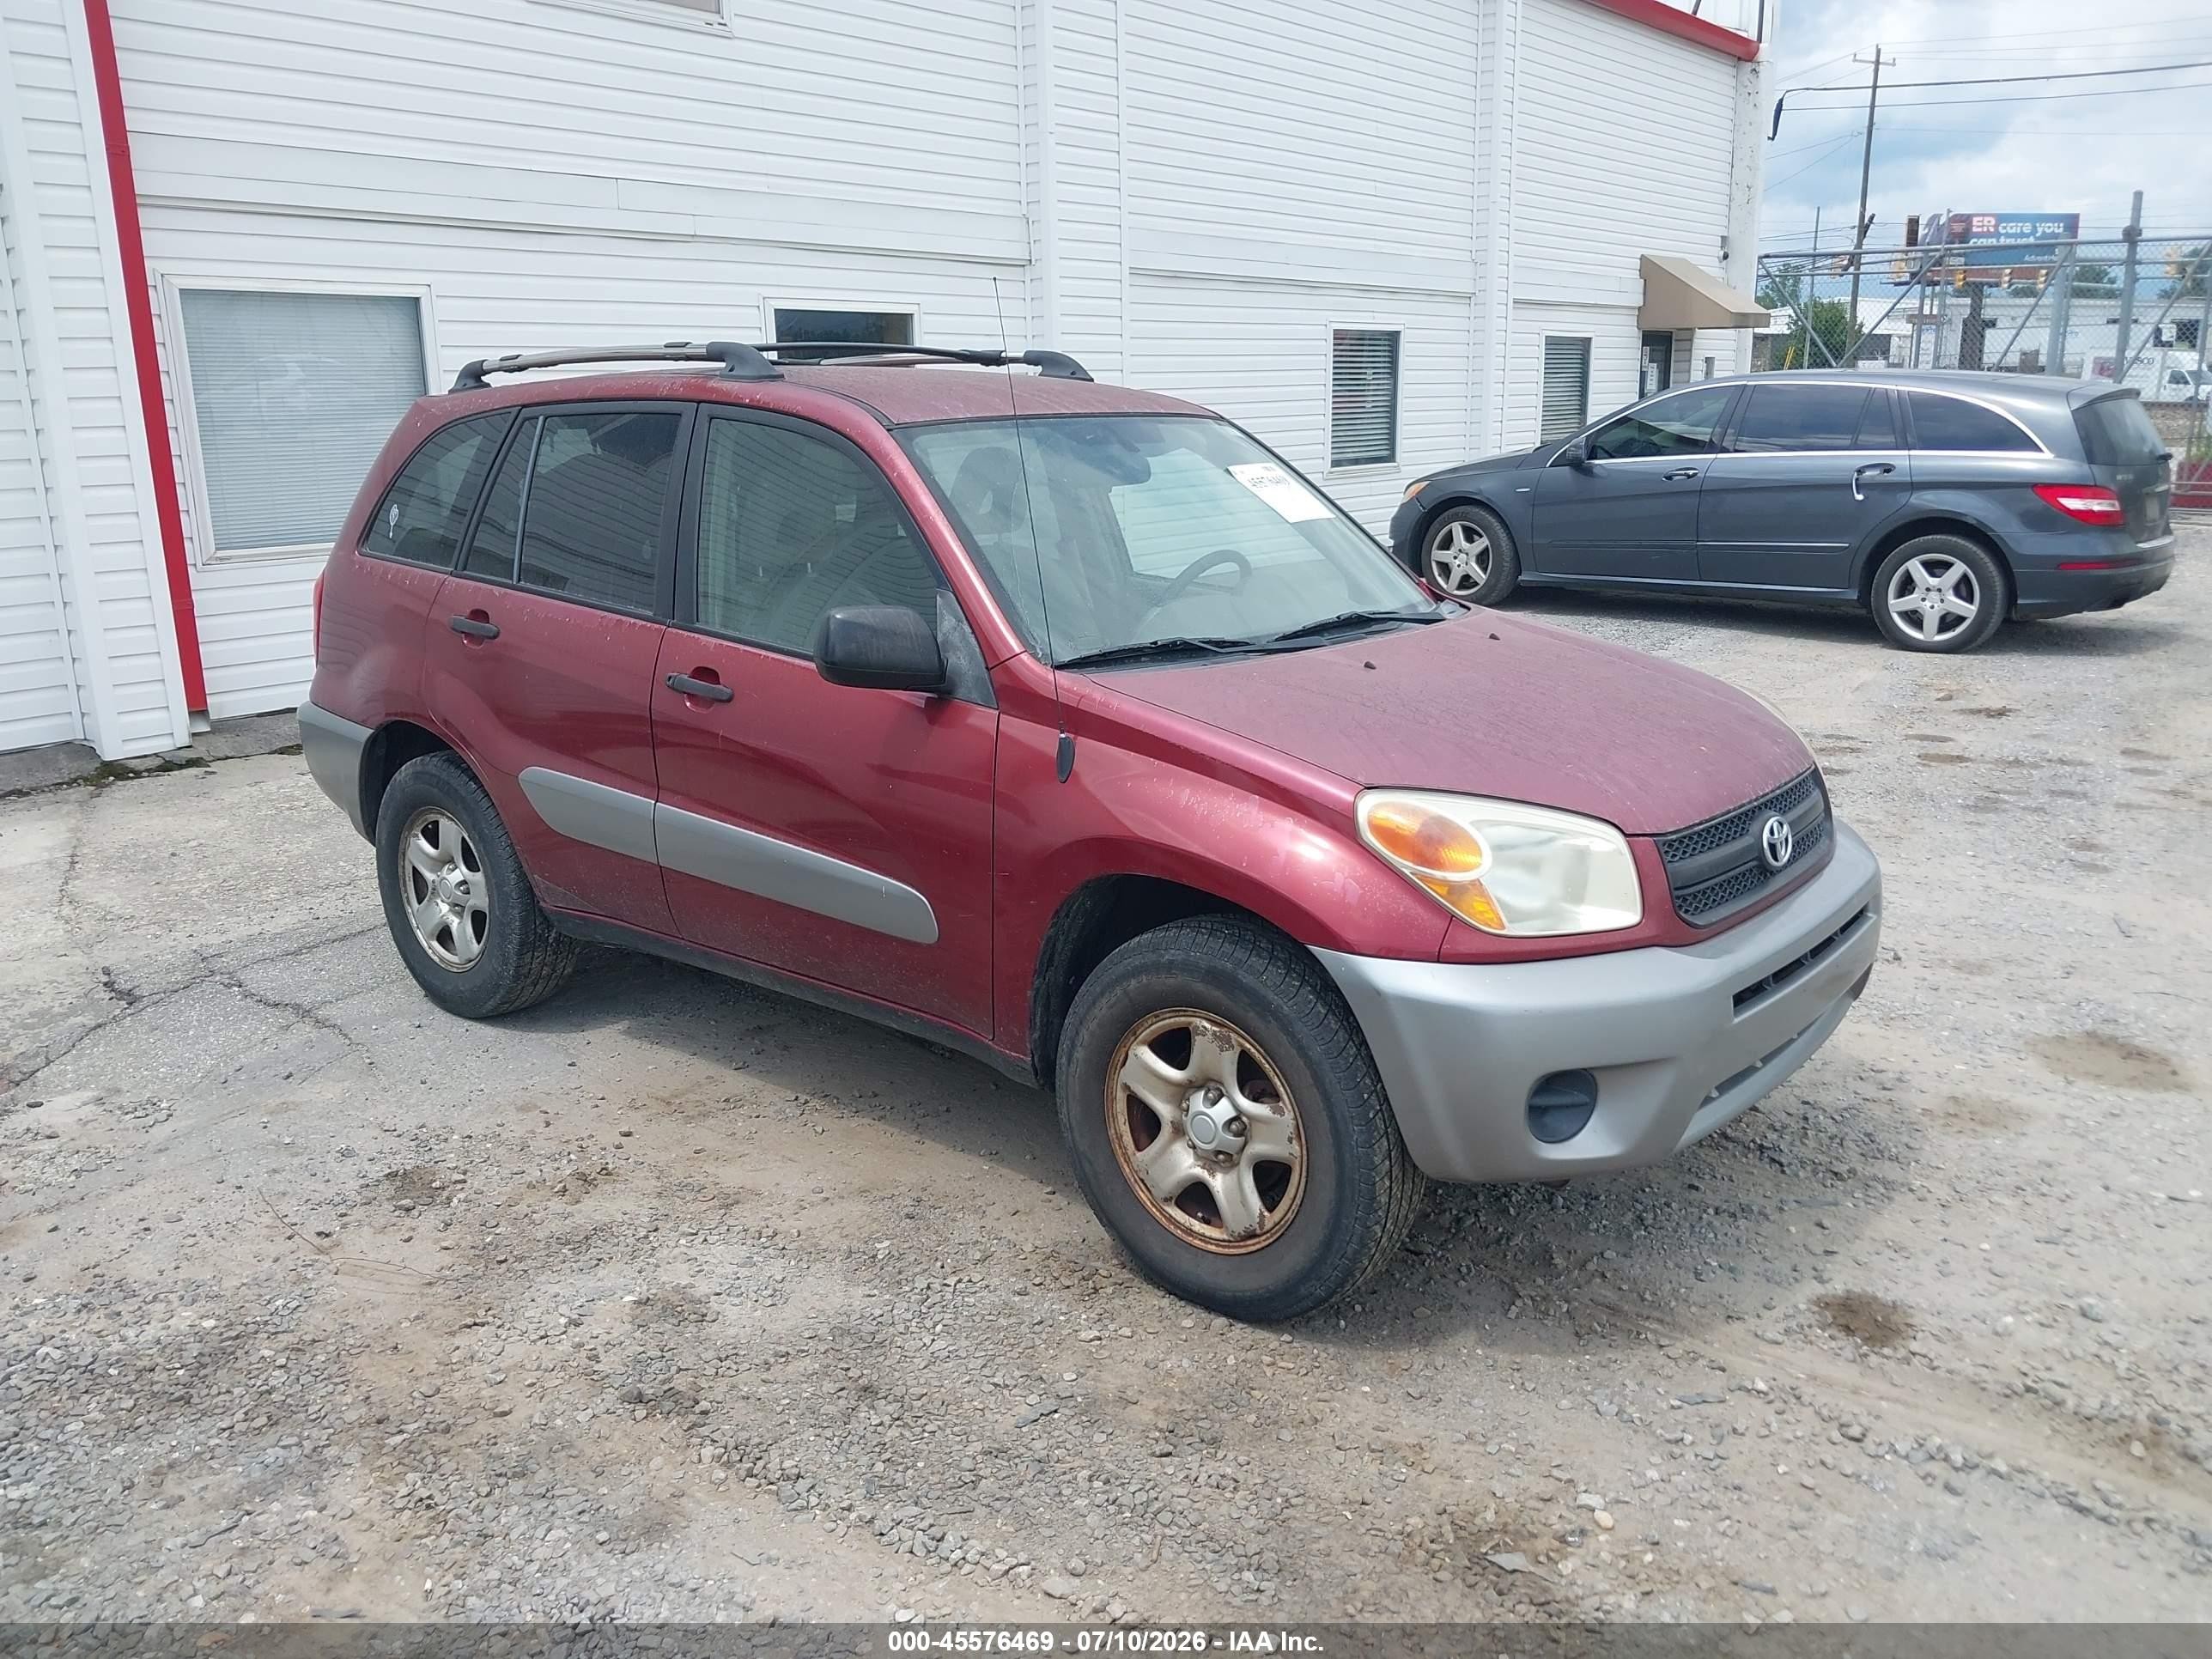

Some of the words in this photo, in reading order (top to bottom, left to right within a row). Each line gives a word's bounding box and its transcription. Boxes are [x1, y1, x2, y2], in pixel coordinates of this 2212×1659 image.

[1972, 216, 1996, 232] ER
[1998, 222, 2033, 234] care
[2035, 222, 2064, 237] you
